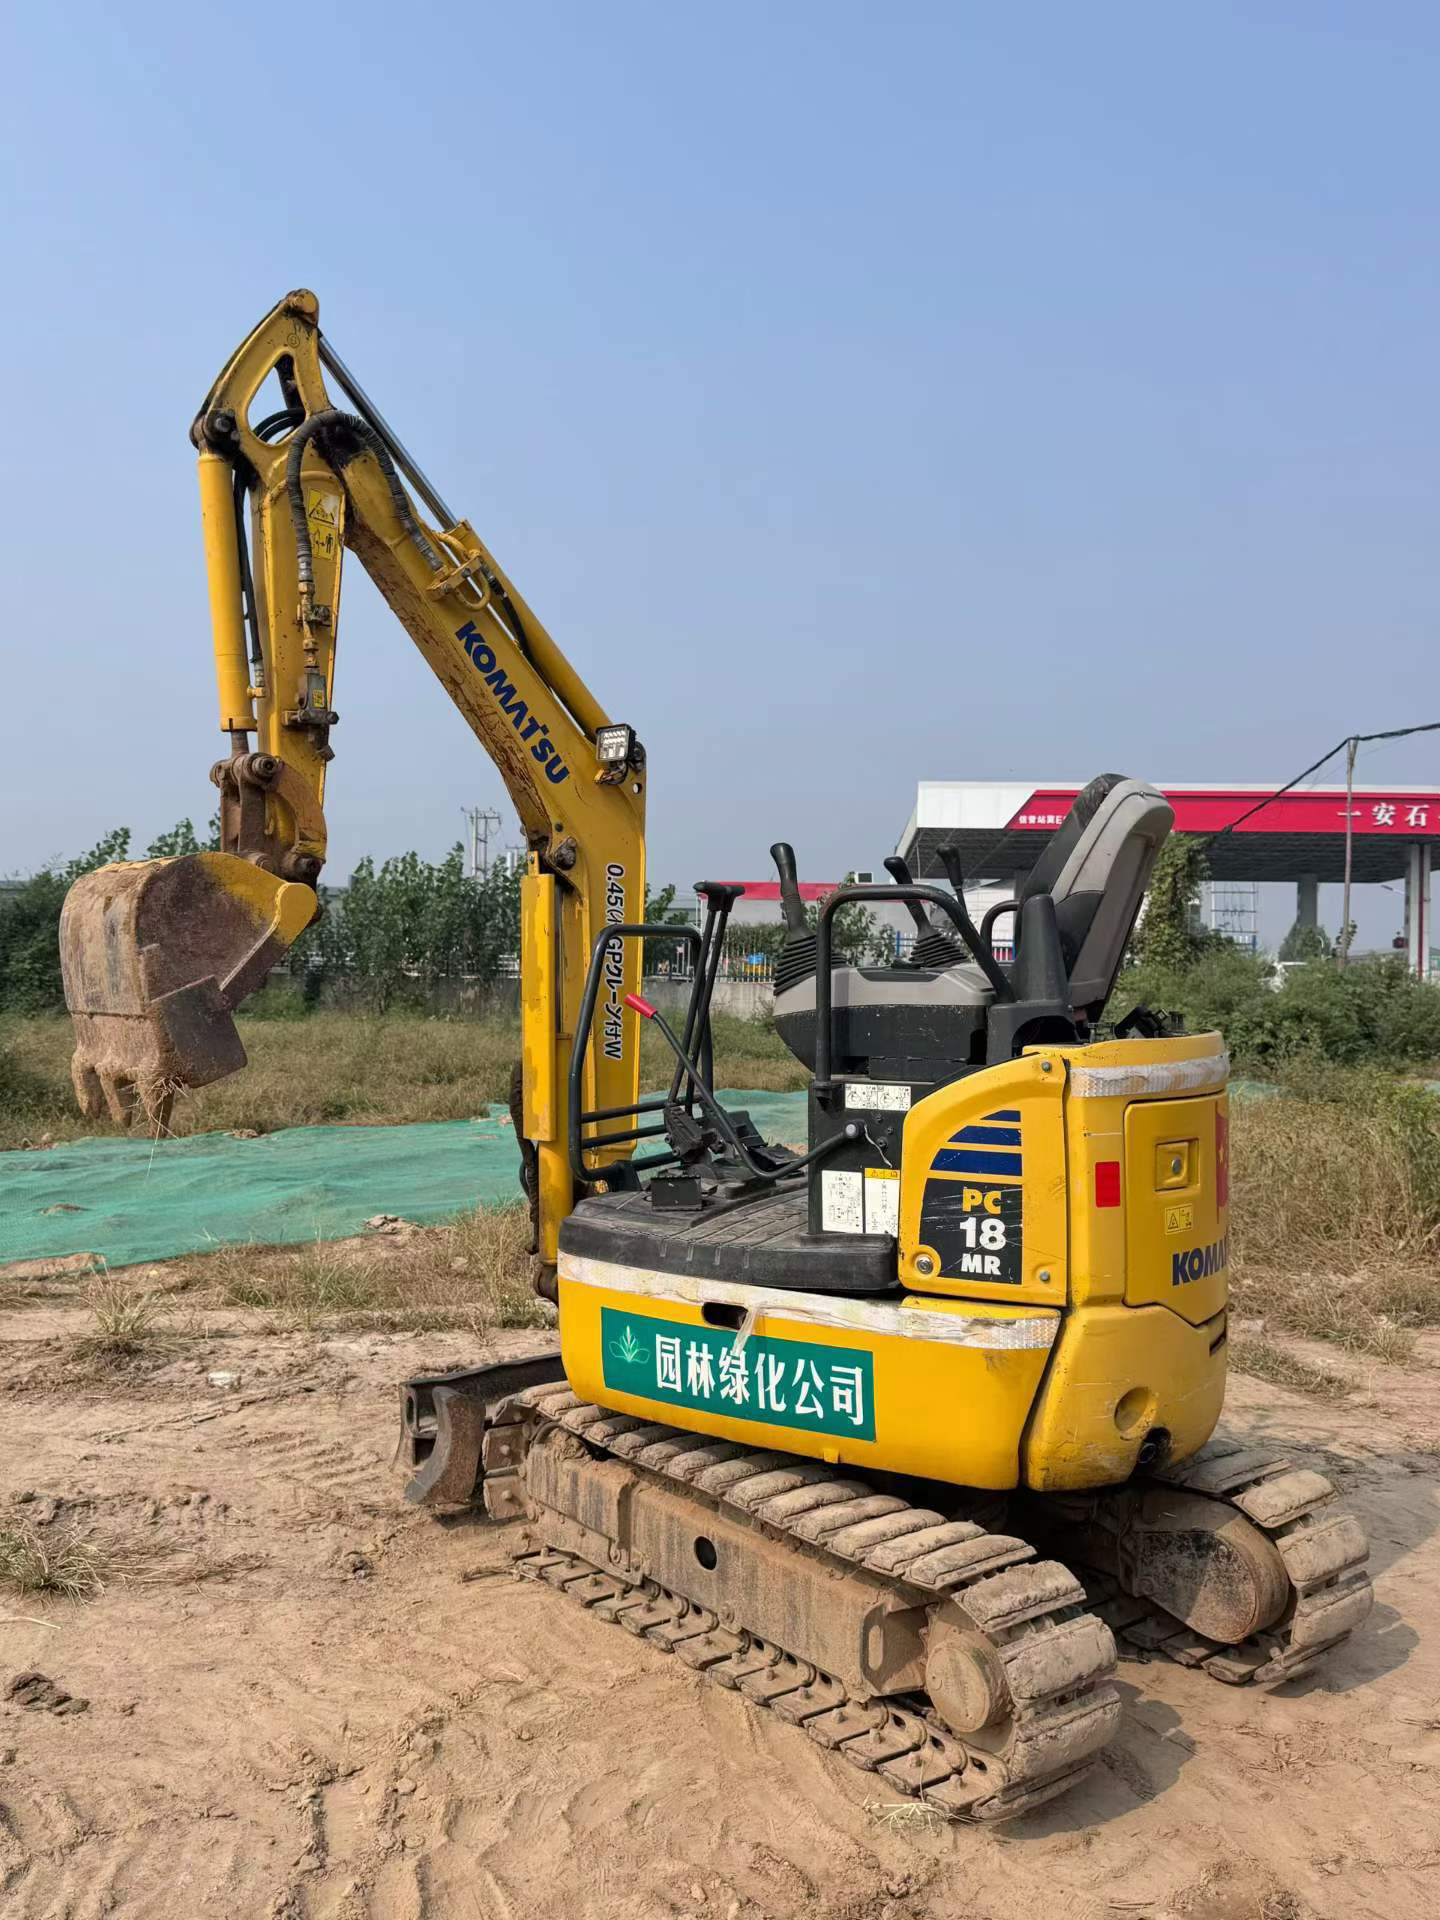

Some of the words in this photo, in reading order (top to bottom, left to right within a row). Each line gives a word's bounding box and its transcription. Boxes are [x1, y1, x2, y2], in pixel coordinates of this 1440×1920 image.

[455, 620, 570, 784] KOMATSU
[1336, 802, 1440, 827] 一安石
[962, 1187, 1002, 1215] PC
[960, 1216, 1006, 1251] 18
[961, 1253, 1001, 1275] MR
[655, 1333, 863, 1426] 园林绿化公司
